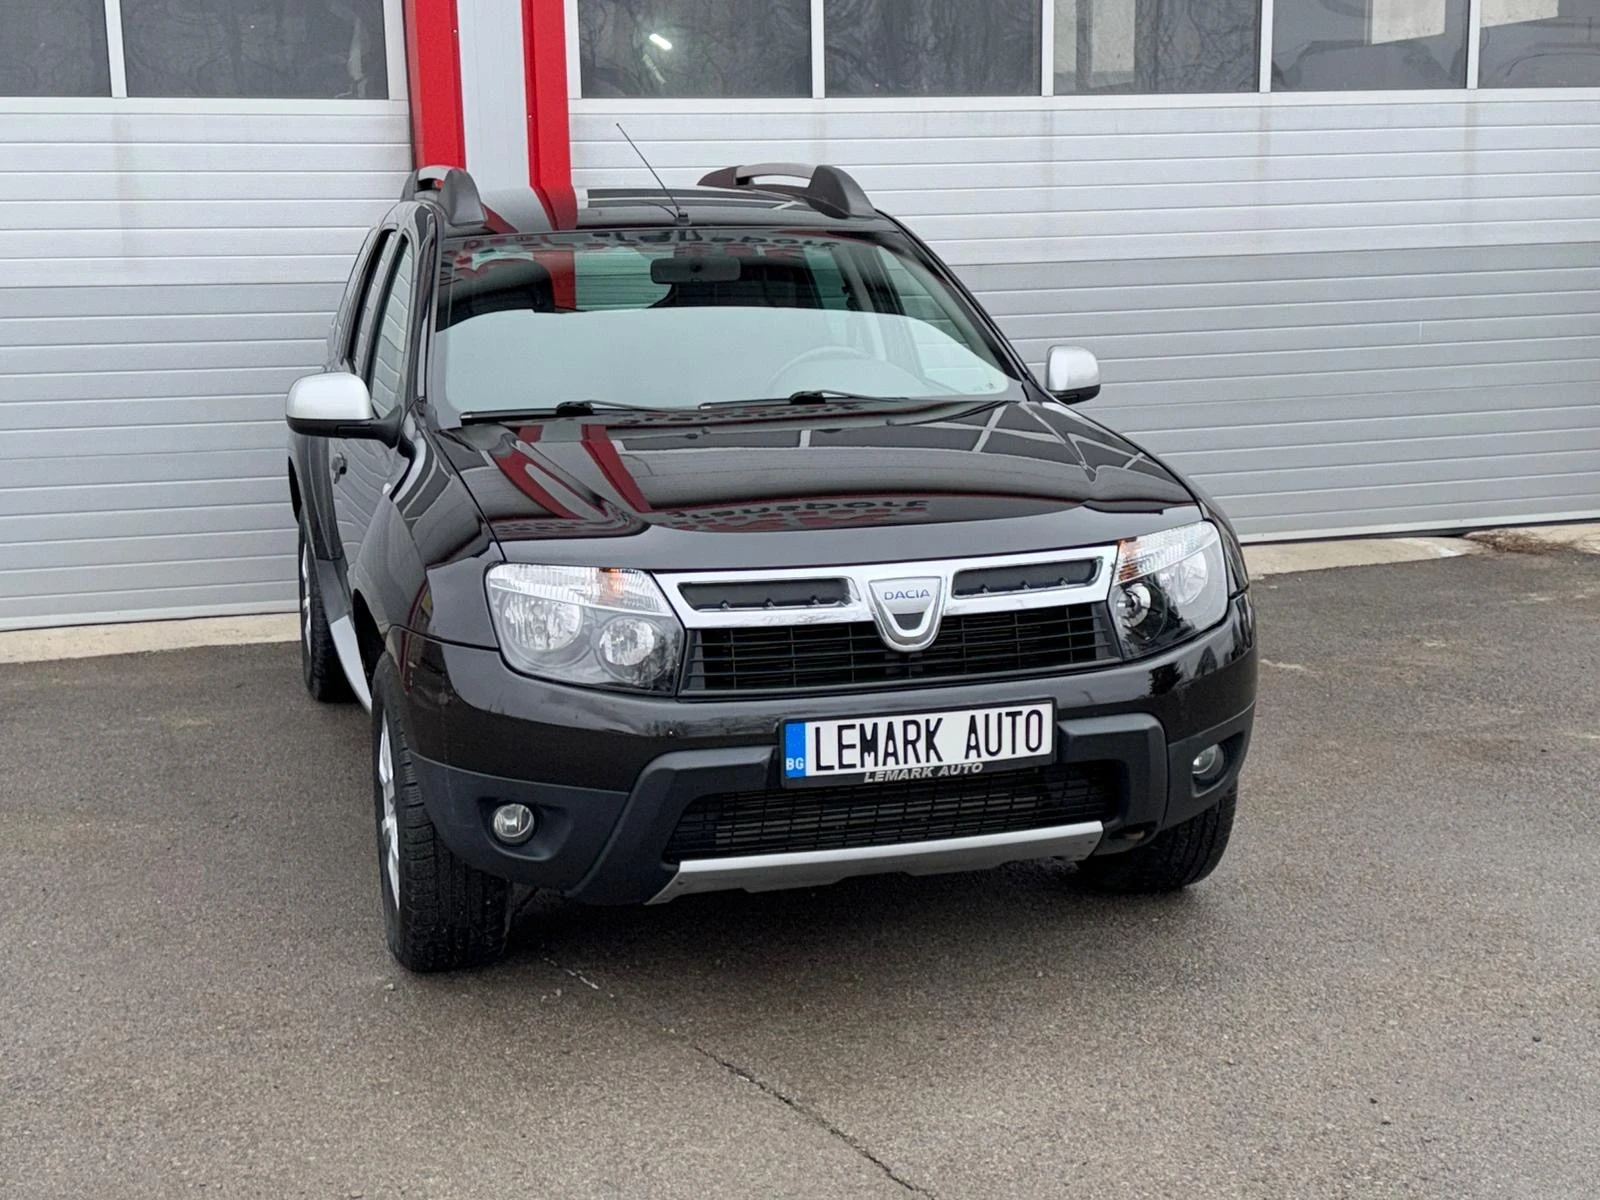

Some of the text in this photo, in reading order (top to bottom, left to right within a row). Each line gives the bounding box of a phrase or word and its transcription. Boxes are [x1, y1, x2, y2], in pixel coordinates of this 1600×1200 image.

[884, 589, 930, 600] DACIA
[815, 709, 1044, 771] LEMARK AUTO
[786, 757, 804, 771] BG
[863, 762, 984, 783] LEMARK AUTO
